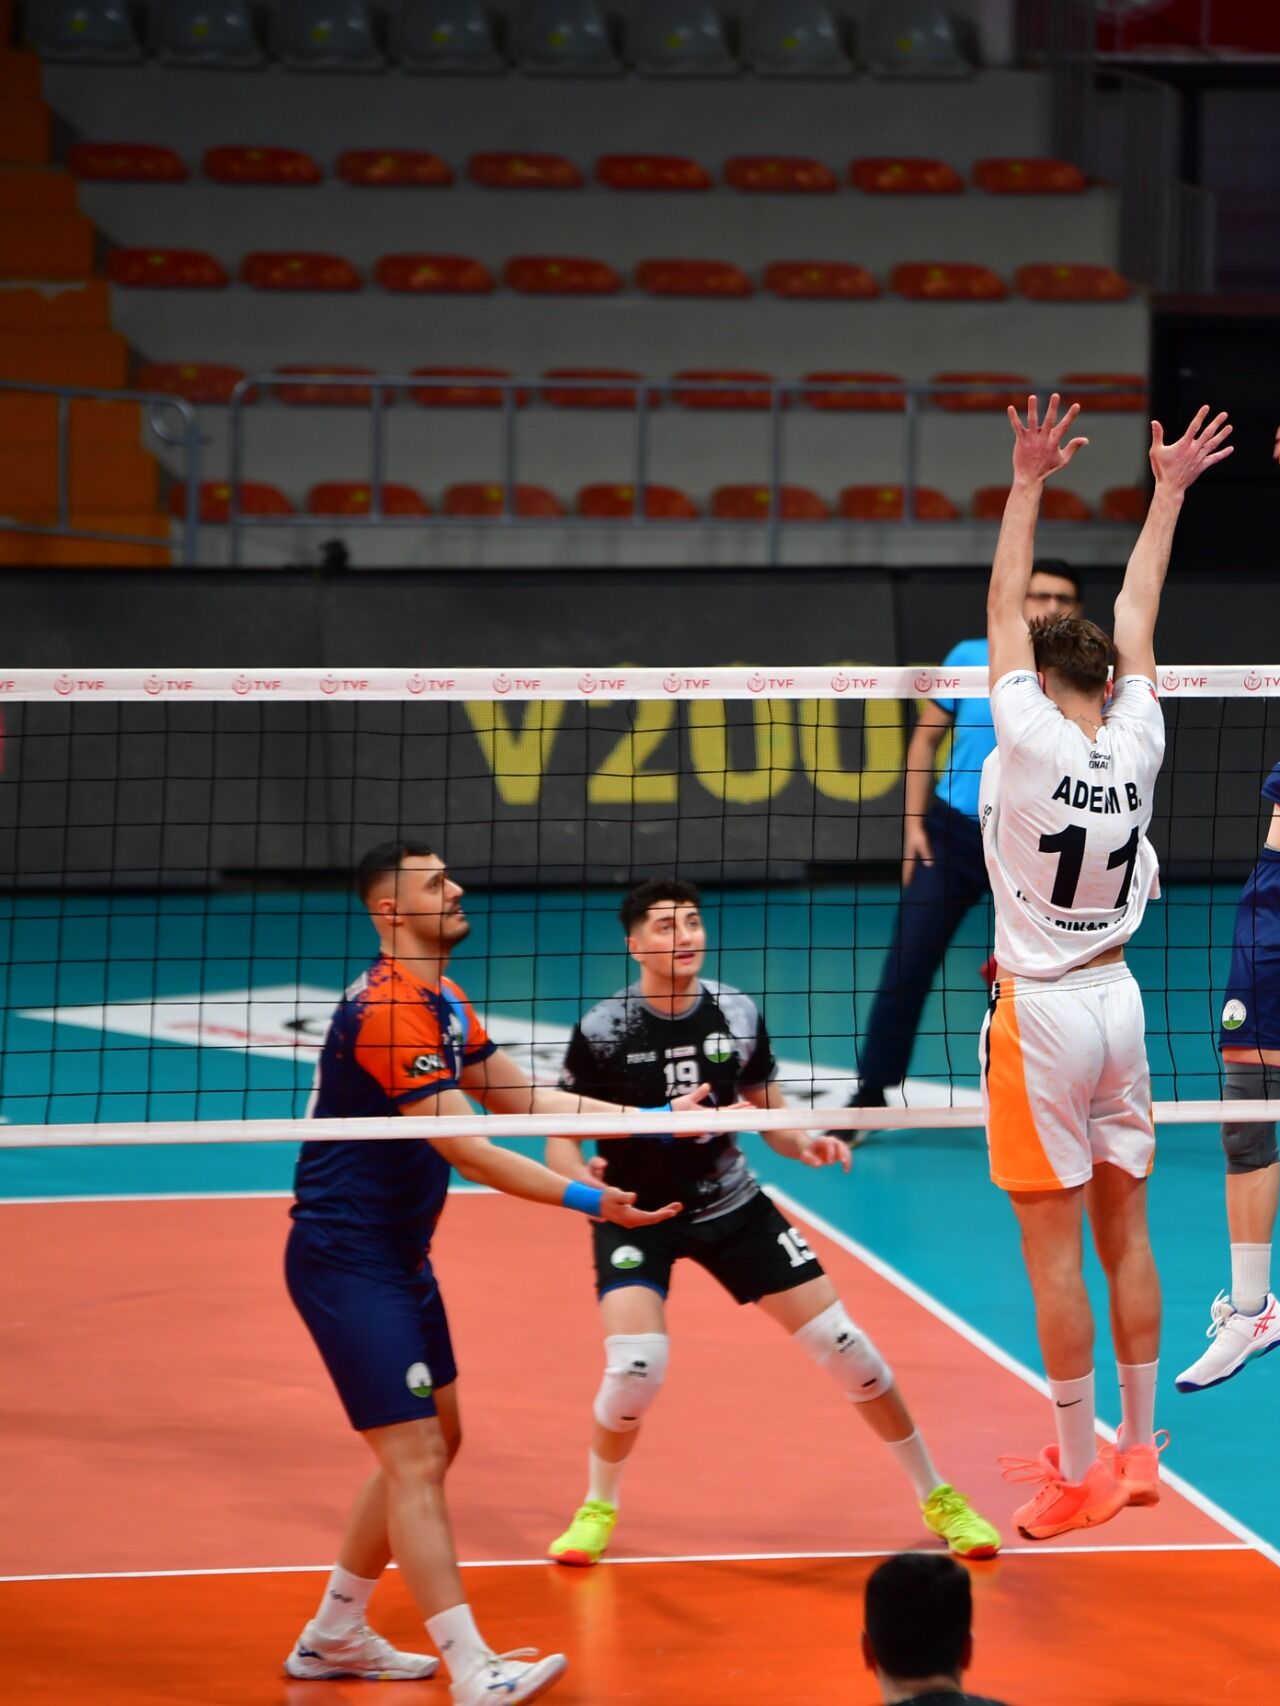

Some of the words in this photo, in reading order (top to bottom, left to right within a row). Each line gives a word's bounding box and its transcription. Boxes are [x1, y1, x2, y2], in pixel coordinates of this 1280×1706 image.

[77, 680, 104, 692] TVF
[166, 680, 193, 692] TVF
[255, 680, 281, 691] TVF
[341, 680, 368, 691] TVF
[429, 680, 455, 691] TVF
[515, 679, 540, 691] TVF
[600, 679, 625, 690] TVF
[684, 679, 710, 690] TVF
[768, 678, 794, 689] TVF
[852, 678, 877, 689] TVF
[935, 678, 960, 689] TVF
[1182, 676, 1207, 688] TVF
[1052, 776, 1121, 814] ADEM
[1125, 782, 1142, 812] B.
[1038, 824, 1139, 909] 11
[664, 1059, 699, 1097] 19
